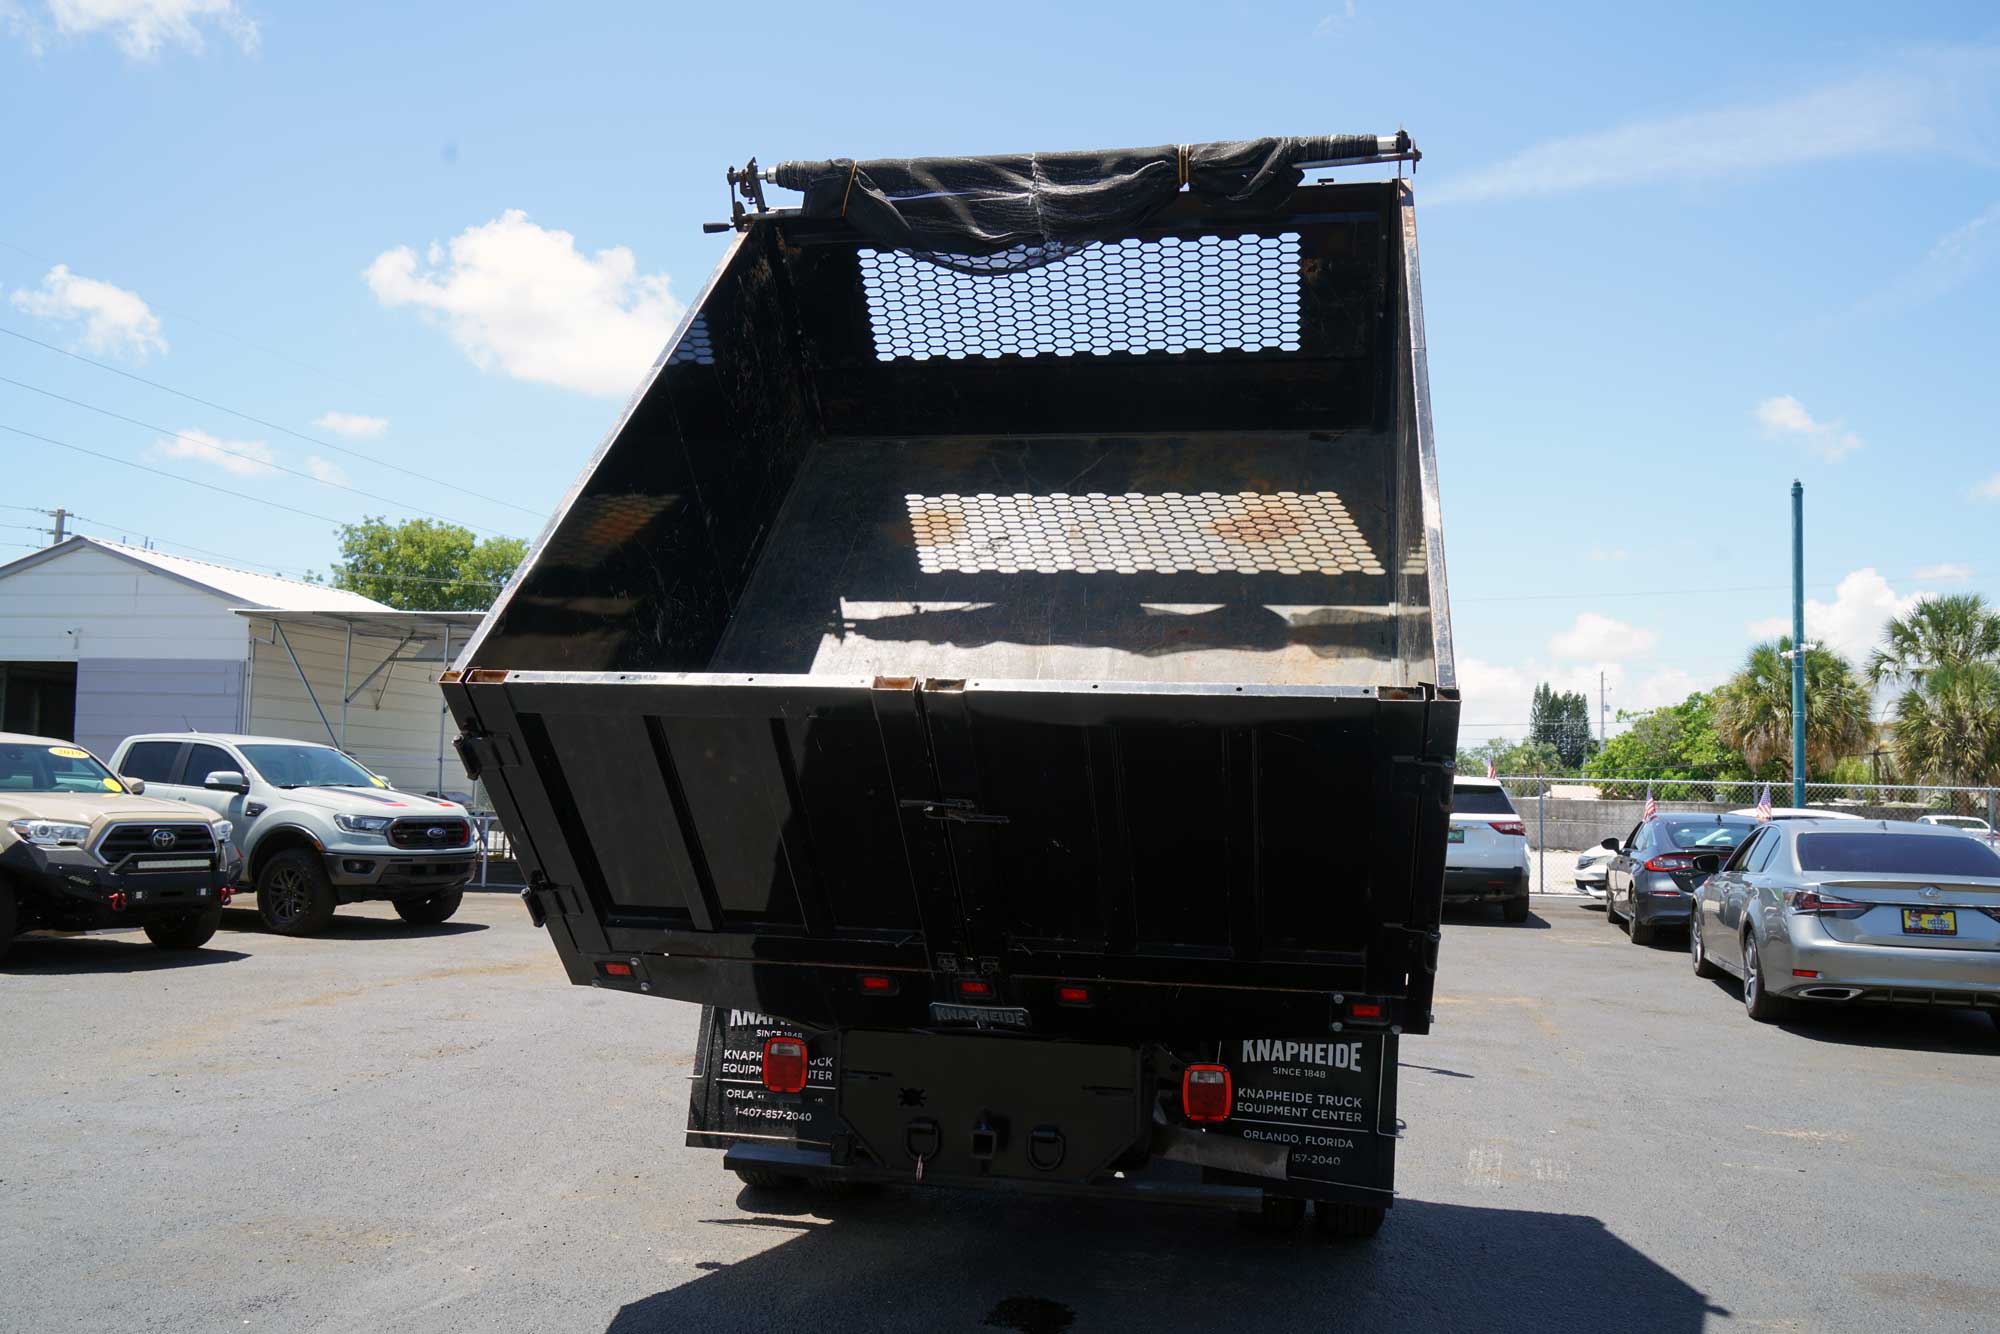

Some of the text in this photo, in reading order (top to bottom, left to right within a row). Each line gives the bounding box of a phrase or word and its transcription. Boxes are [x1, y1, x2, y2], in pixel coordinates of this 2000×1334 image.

[724, 1049, 763, 1062] KNAPH
[1242, 1039, 1362, 1072] KNAPHEIDE
[1272, 1066, 1326, 1078] SINCE 1848
[1238, 1087, 1362, 1108] KNAPHEIDE TRUCK
[735, 1107, 812, 1122] 1-407-857-2040
[1237, 1102, 1362, 1123] EQUIPMENT CENTER
[1243, 1129, 1354, 1149] ORLANDO, FLORIDA
